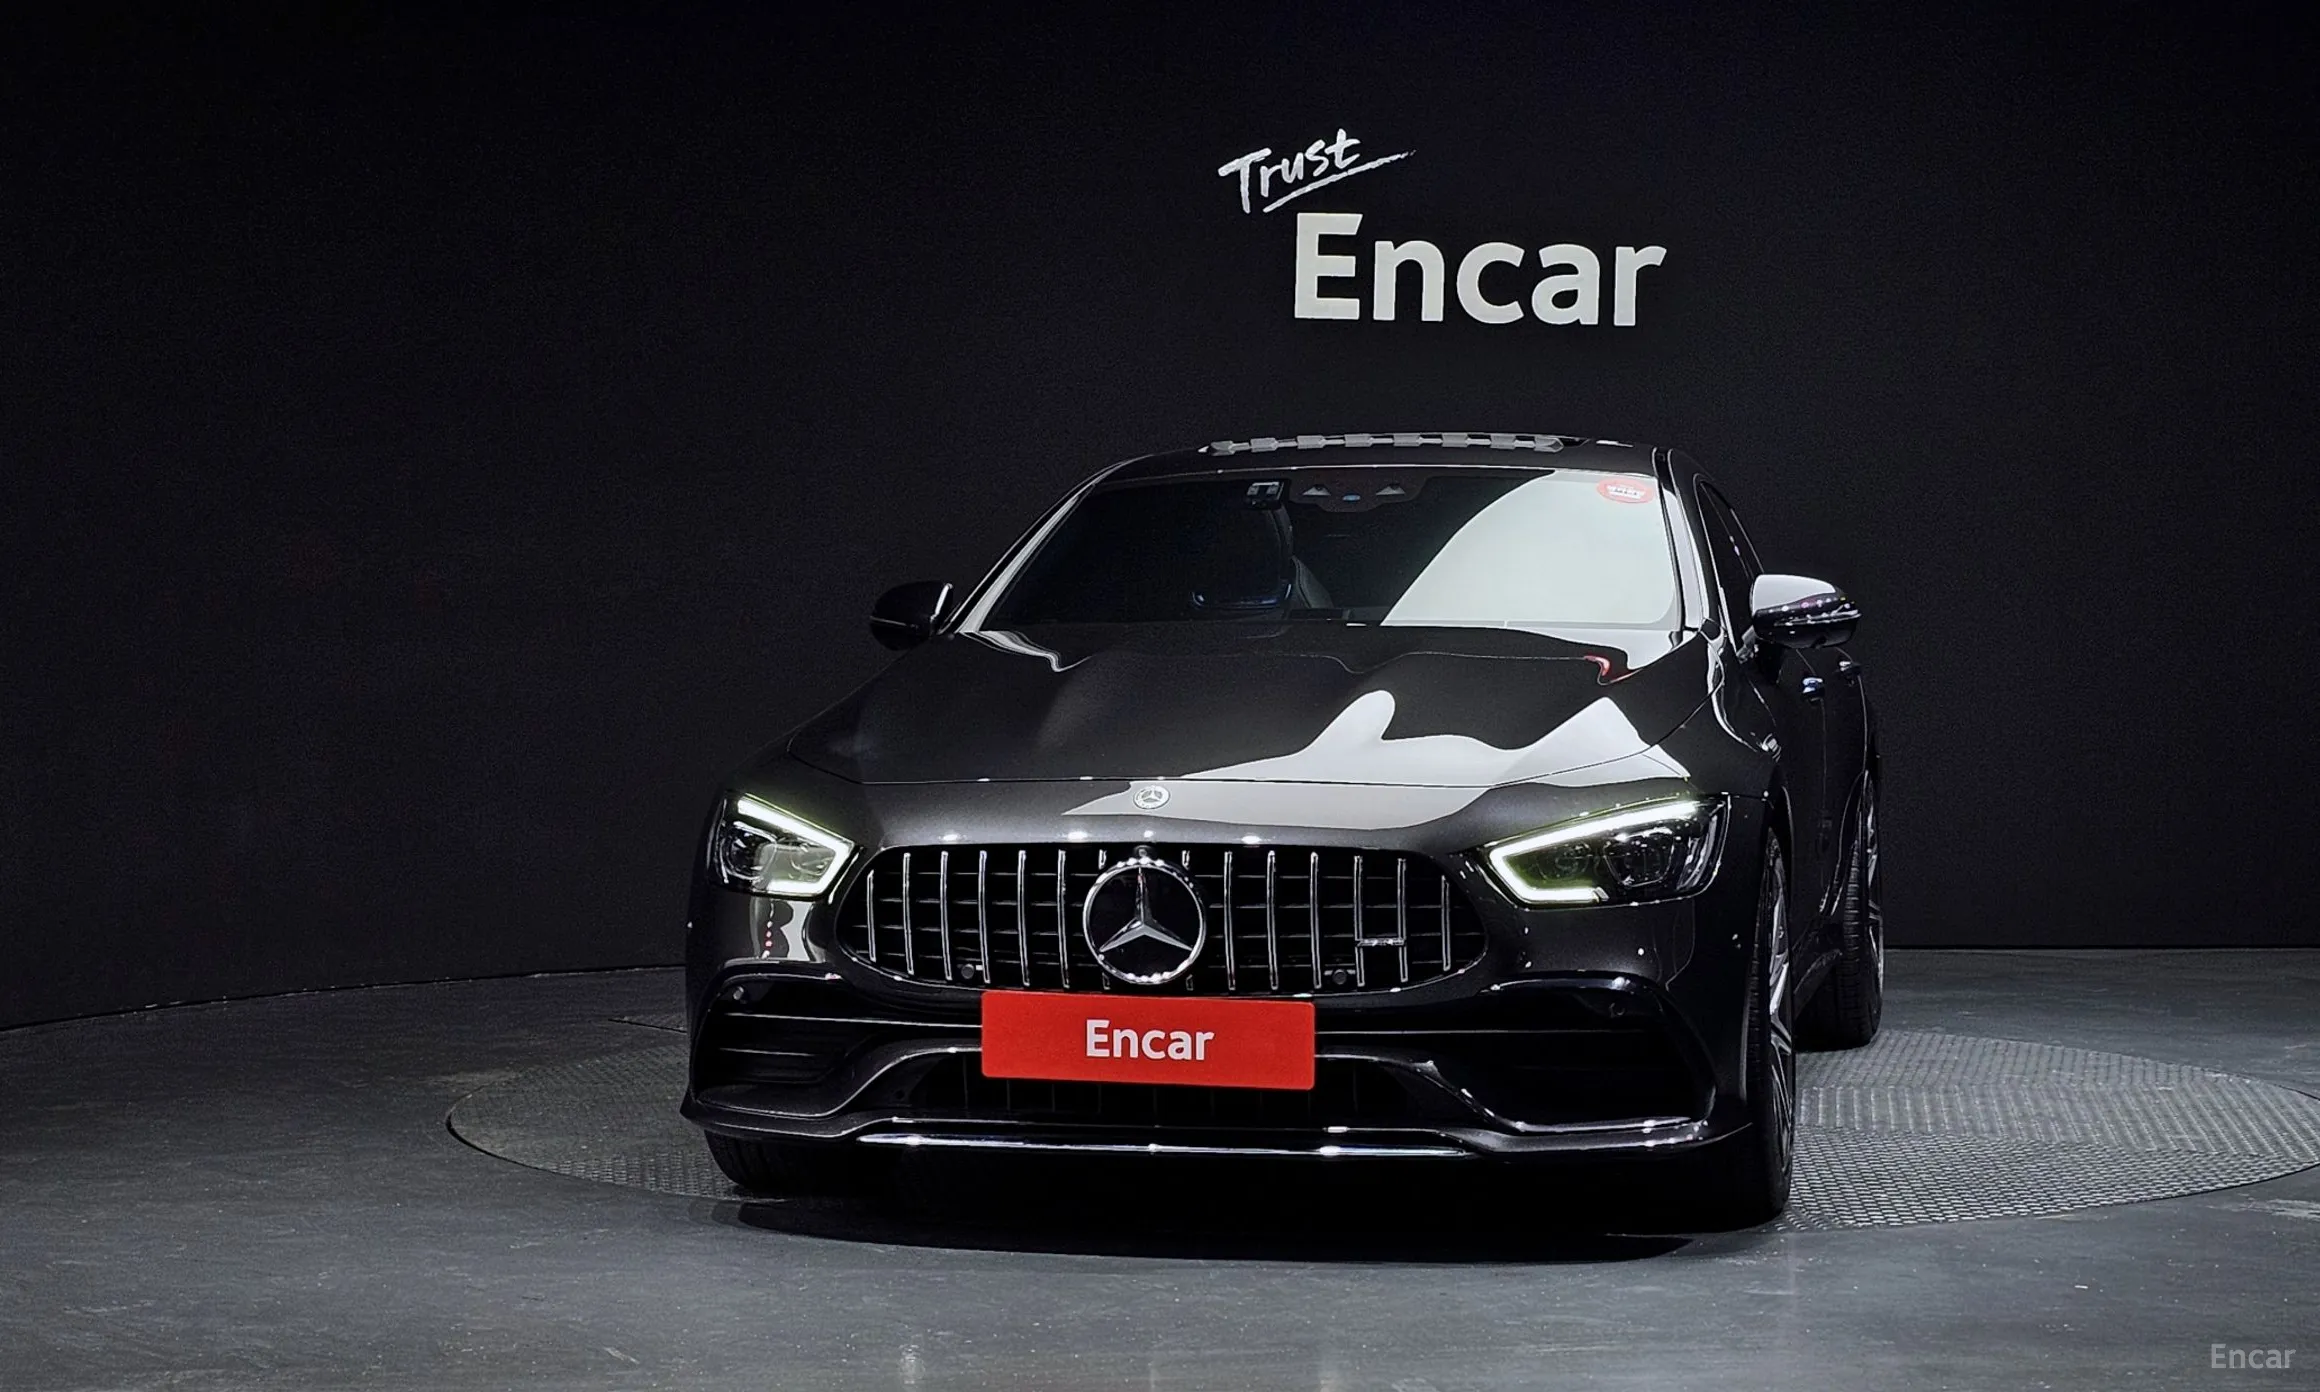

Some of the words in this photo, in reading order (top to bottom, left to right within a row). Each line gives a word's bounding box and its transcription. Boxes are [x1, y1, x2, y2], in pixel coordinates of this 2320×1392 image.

[1218, 128, 1361, 213] Trust
[1294, 212, 1667, 326] Encar
[1086, 1019, 1214, 1061] Encar
